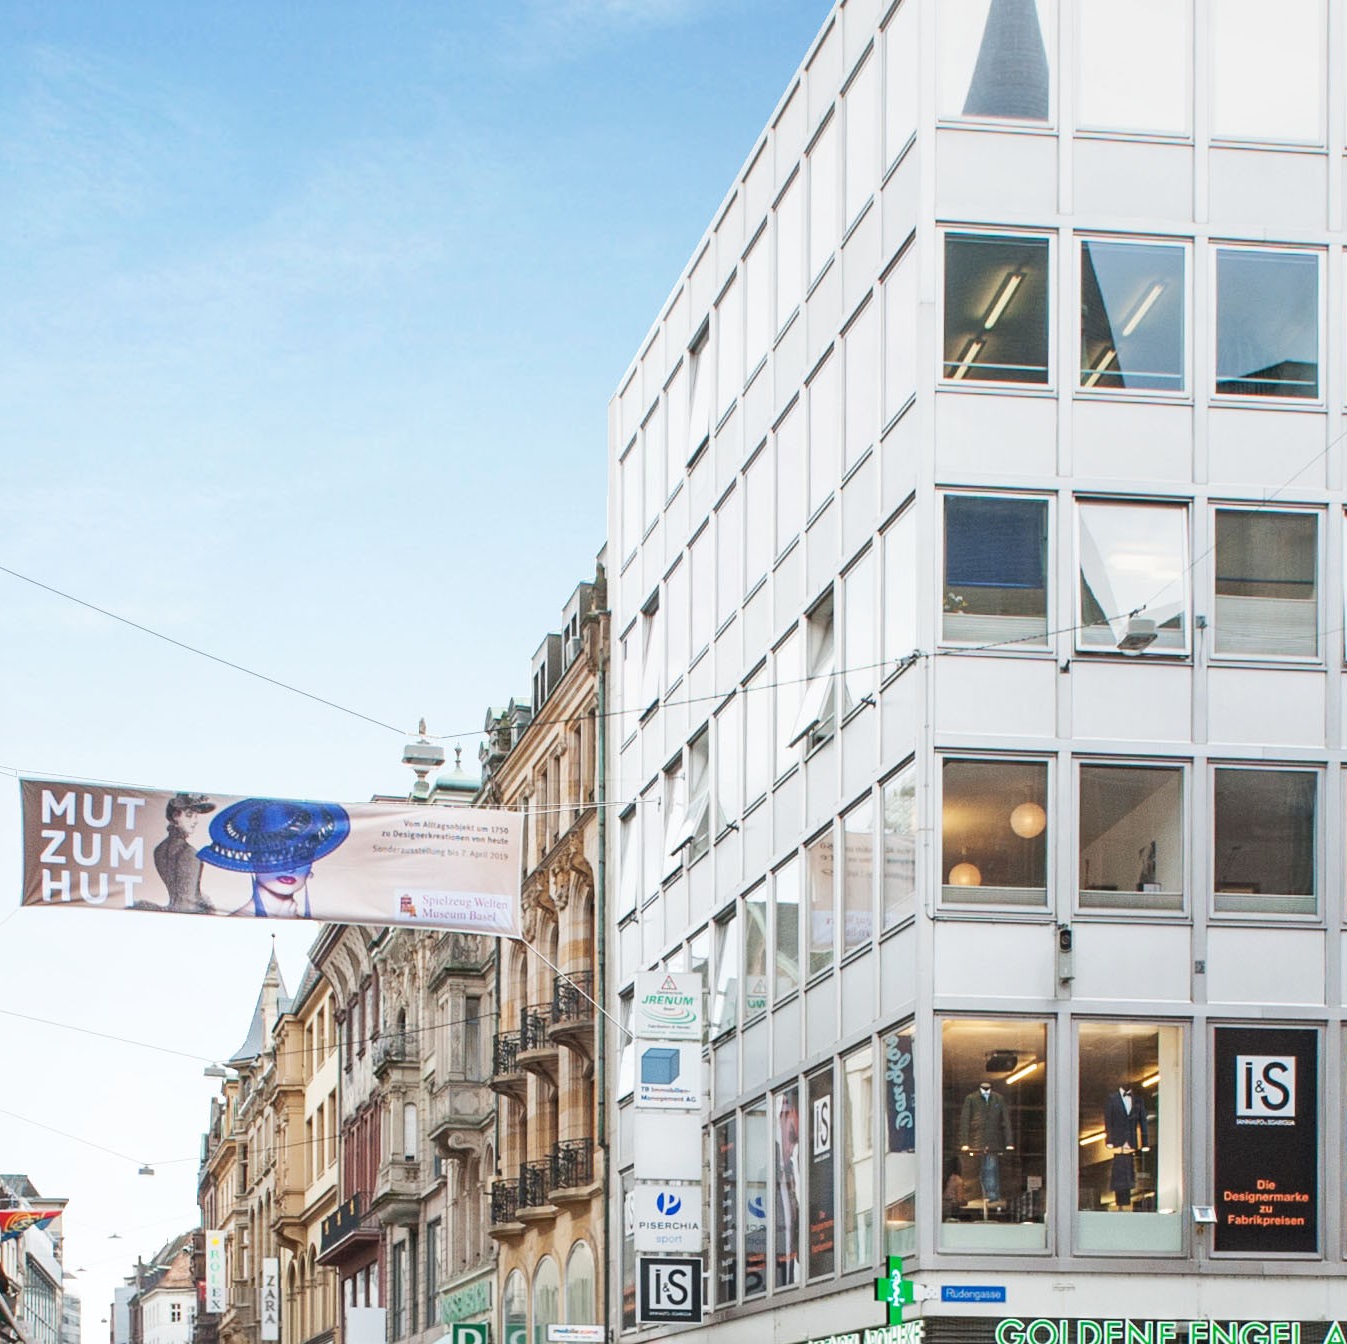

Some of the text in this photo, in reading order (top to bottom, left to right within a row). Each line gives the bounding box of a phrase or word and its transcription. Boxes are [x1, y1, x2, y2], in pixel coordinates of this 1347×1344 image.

[42, 790, 145, 830] MUT
[487, 836, 509, 845] heute
[40, 829, 143, 870] ZUM
[42, 868, 143, 907] HUT
[422, 895, 508, 910] Spielzeug Welten
[421, 908, 496, 922] Museum Basel
[1256, 1179, 1276, 1190] Die
[1224, 1191, 1309, 1203] Designermarke
[1259, 1205, 1273, 1213] zu
[639, 1221, 699, 1230] PISERCHIA
[1228, 1215, 1304, 1226] Fabrikpreisen
[210, 1250, 221, 1309] ROLEX
[264, 1275, 276, 1324] ZARA
